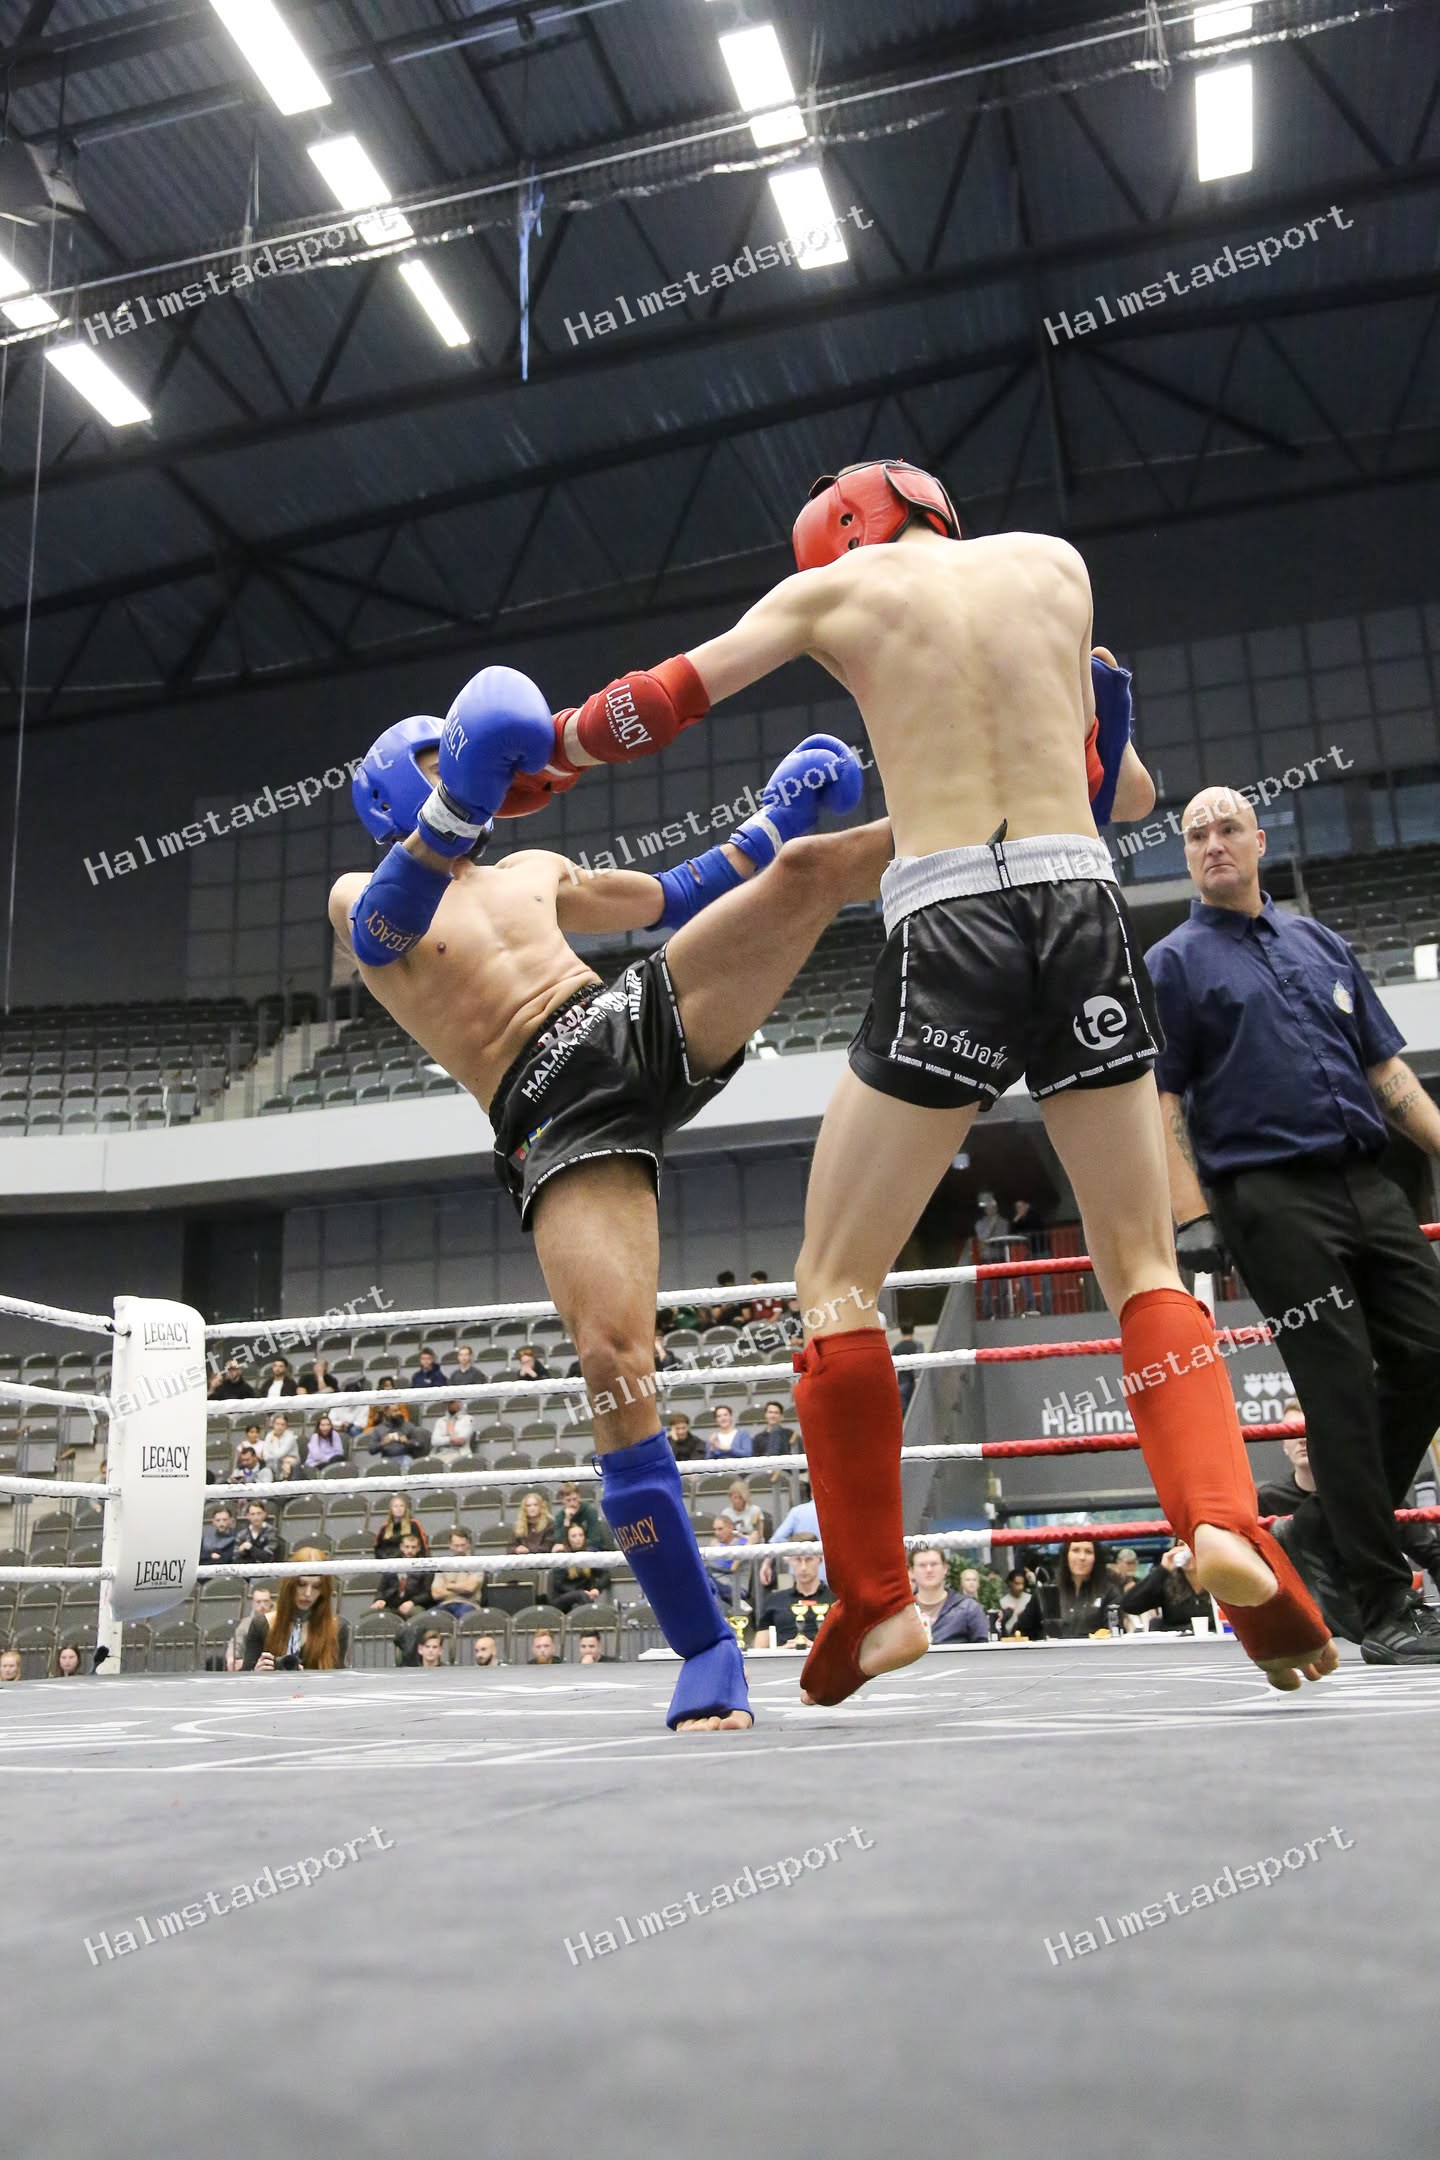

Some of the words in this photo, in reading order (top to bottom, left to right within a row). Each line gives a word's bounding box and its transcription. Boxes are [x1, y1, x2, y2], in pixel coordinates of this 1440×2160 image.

[446, 707, 468, 760] GACY
[606, 684, 652, 749] LEGACY
[143, 1322, 189, 1345] LEGACY
[1041, 1406, 1135, 1436] Halms
[1234, 1398, 1284, 1422] ren
[142, 1446, 190, 1472] LEGACY
[614, 1516, 659, 1552] LEGACY
[135, 1559, 186, 1586] LEGACY
